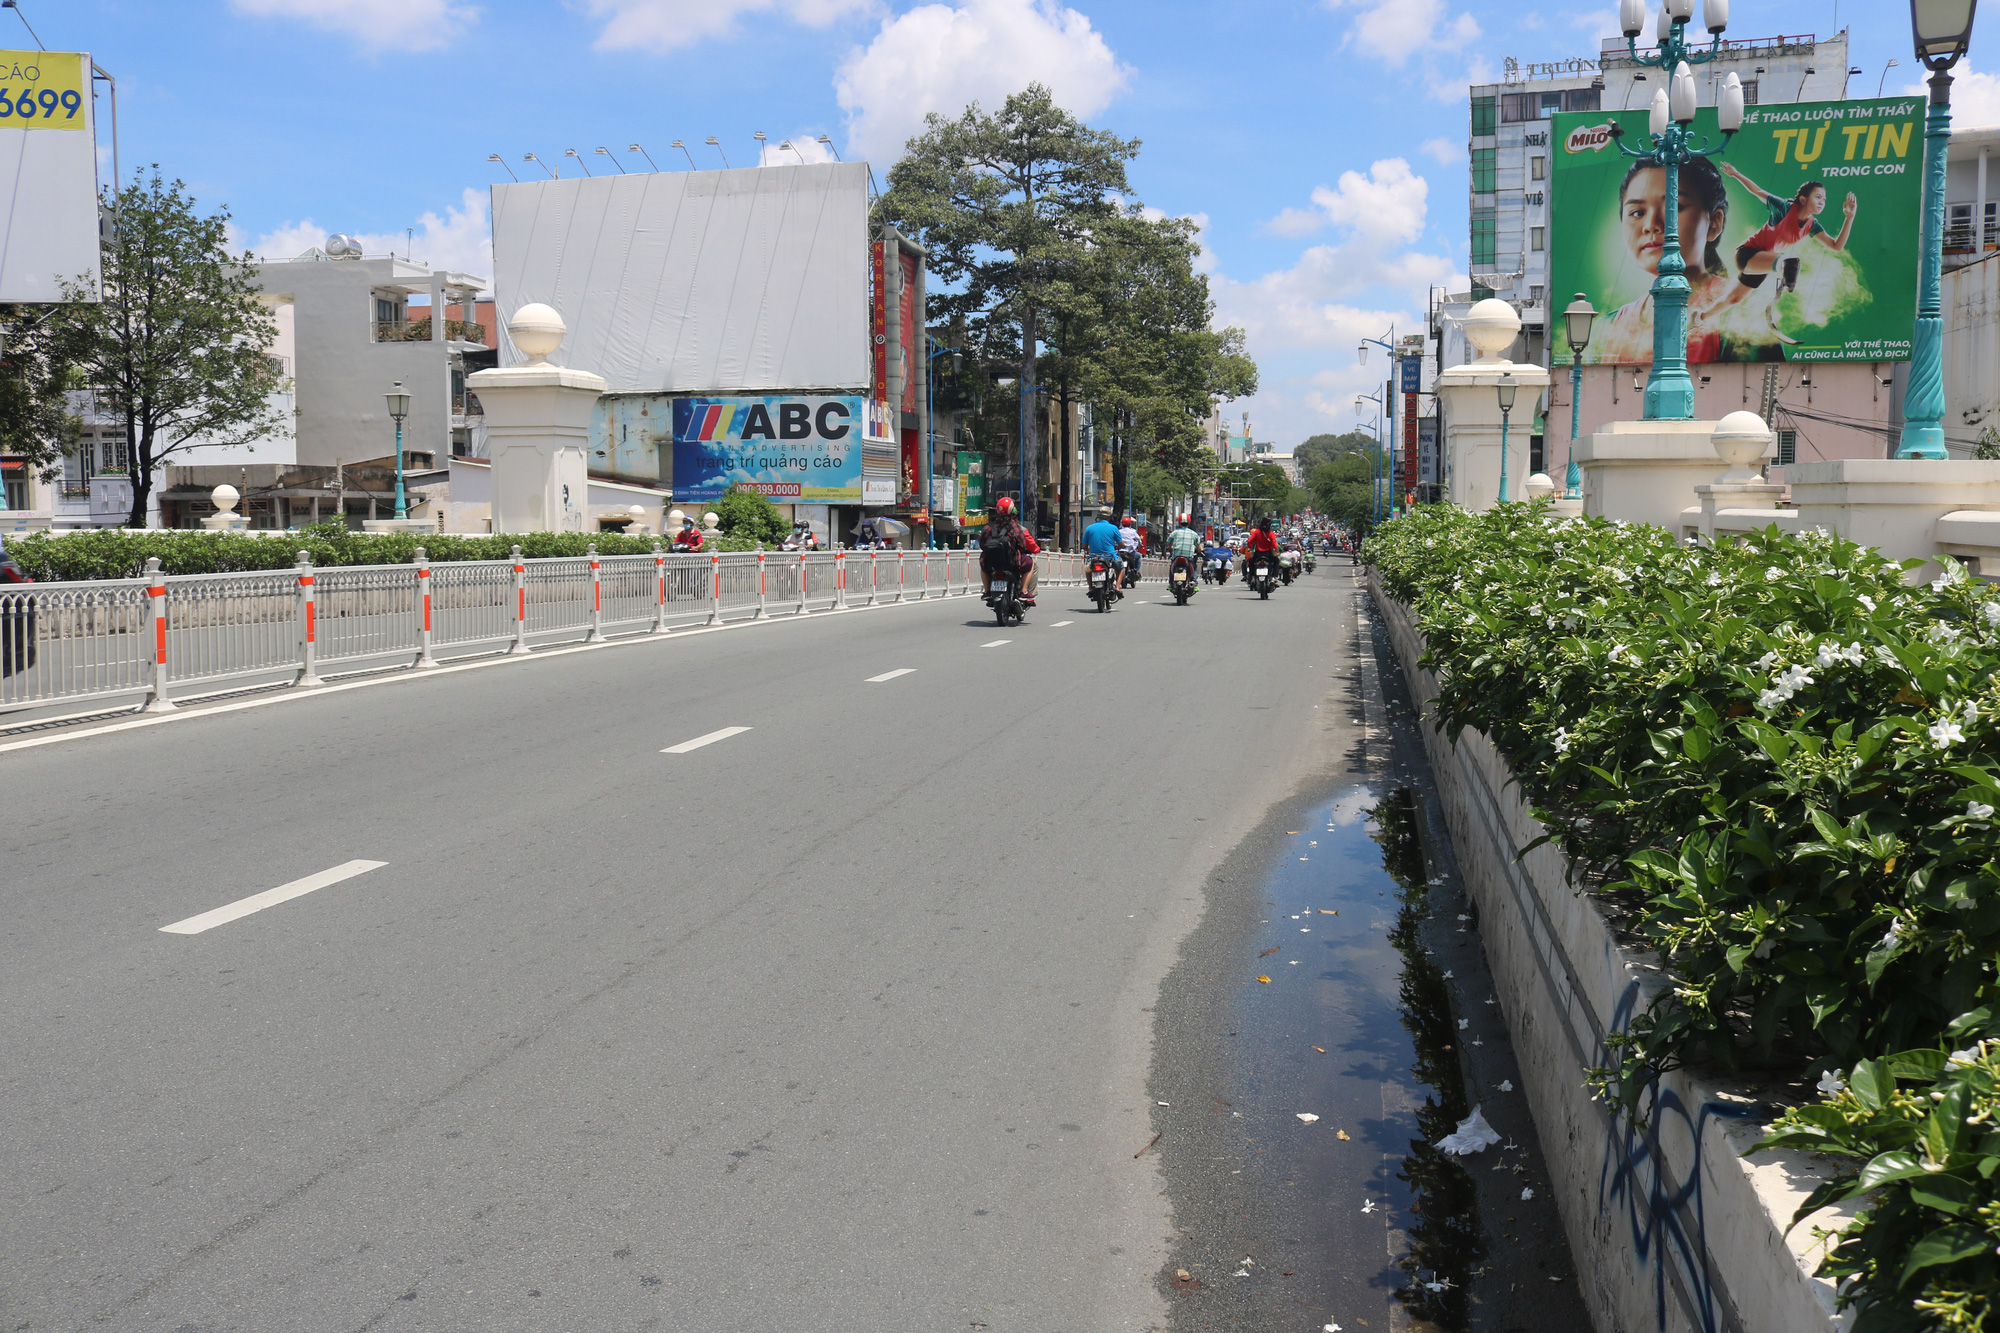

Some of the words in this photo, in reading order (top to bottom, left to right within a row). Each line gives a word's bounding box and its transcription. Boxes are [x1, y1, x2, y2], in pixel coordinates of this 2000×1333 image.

[1527, 56, 1610, 75] TRƯỜNG
[1743, 109, 1760, 124] HỂ
[1763, 112, 1801, 125] THAO
[1804, 107, 1846, 122] LUÔN
[1848, 104, 1876, 121] TÌM
[1876, 101, 1915, 118] THẤY
[1570, 133, 1609, 149] MILO
[1772, 121, 1831, 171] TỰ
[1841, 121, 1914, 161] TIN
[1821, 165, 1871, 178] TRONG
[1873, 163, 1906, 176] CON
[1844, 339, 1861, 348] VỚI
[1863, 338, 1881, 348] THỂ
[1883, 340, 1912, 348] THAO,
[1792, 351, 1803, 359] AI
[1804, 350, 1831, 359] CŨNG
[1832, 349, 1845, 358] LÀ
[1846, 349, 1867, 358] NHÀ
[1869, 349, 1884, 358] VÔ
[1884, 349, 1909, 360] ĐỊCH
[740, 401, 850, 440] ABC
[696, 455, 735, 471] trang
[740, 454, 756, 468] trí
[759, 453, 808, 471] quảng
[813, 454, 842, 468] cáo
